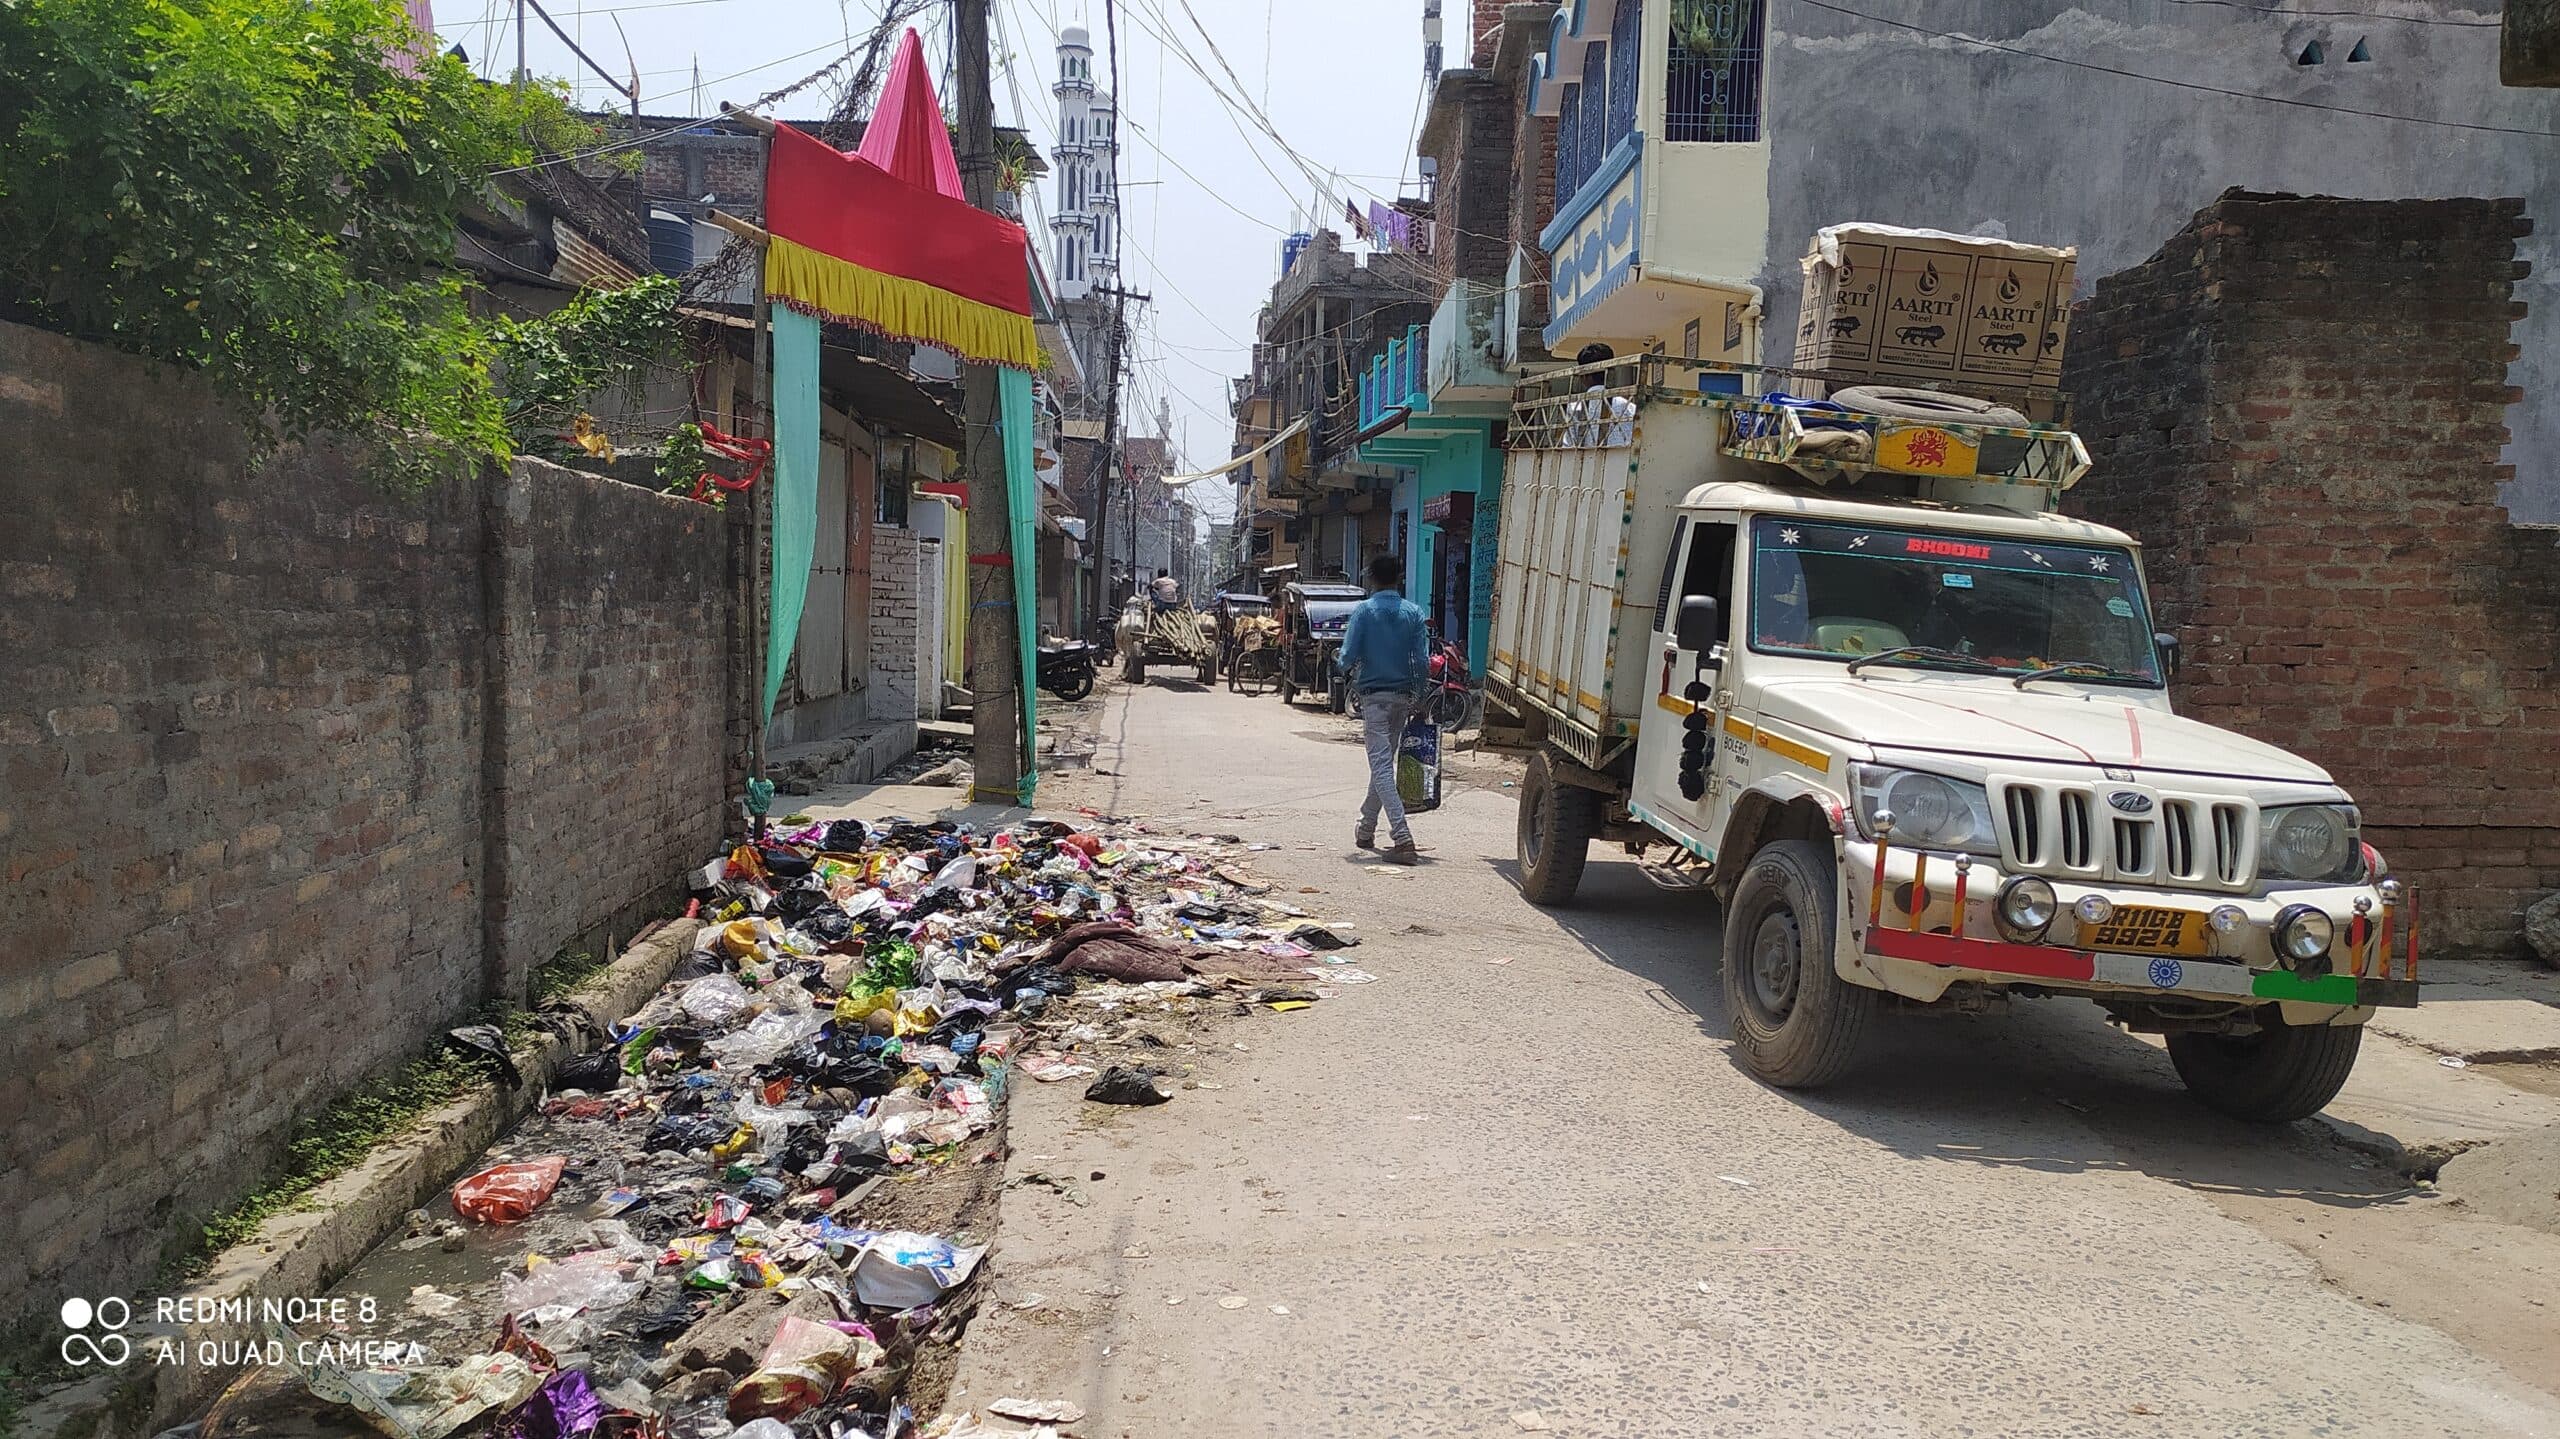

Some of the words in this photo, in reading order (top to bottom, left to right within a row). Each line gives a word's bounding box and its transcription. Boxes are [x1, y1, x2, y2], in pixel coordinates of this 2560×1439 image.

[1891, 297, 1954, 316] AARTI
[1974, 305, 2036, 324] AARTI
[1908, 313, 1932, 323] Steel
[1990, 321, 2015, 330] Steel
[1724, 736, 1748, 756] BOLERO
[2102, 907, 2185, 929] R11GB
[2093, 927, 2181, 948] 9924
